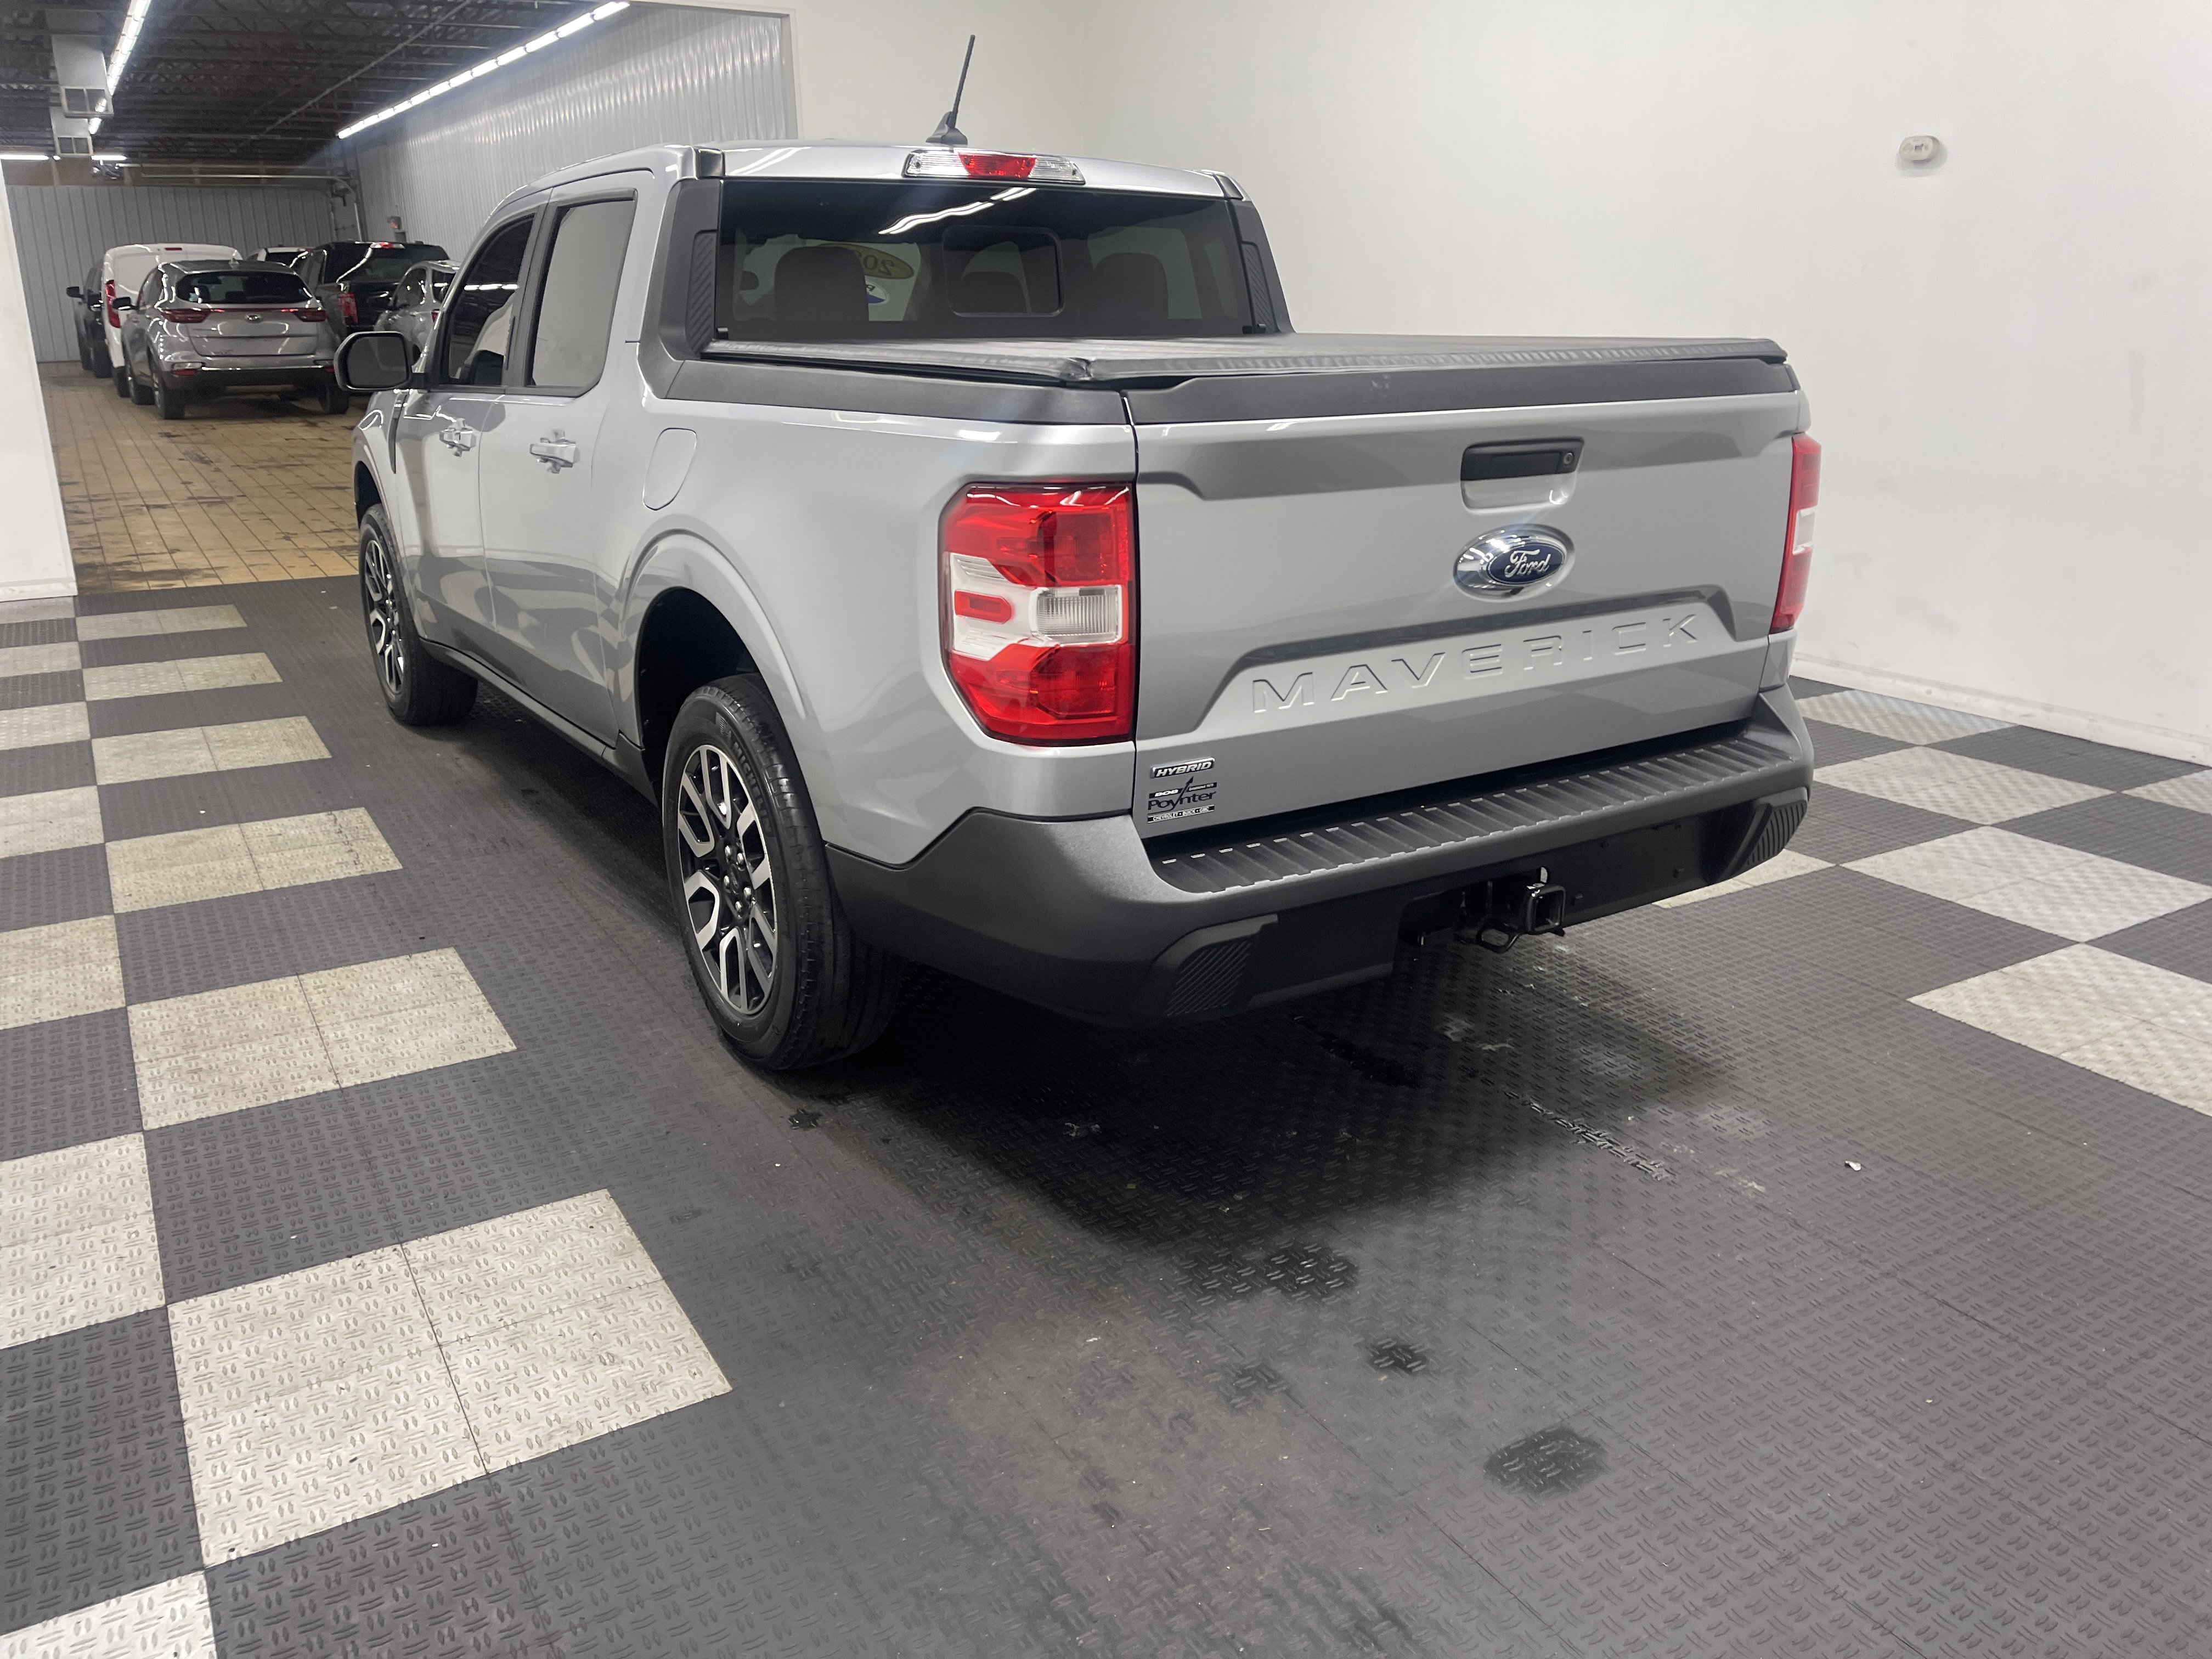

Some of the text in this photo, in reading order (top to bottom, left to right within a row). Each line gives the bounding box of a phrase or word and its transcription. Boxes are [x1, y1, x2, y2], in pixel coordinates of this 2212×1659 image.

[1504, 549, 1551, 578] Ford
[1252, 613, 1698, 713] MAVERICK
[1156, 761, 1212, 777] HYBRID
[731, 741, 773, 836] MICHELIN
[1154, 789, 1179, 797] BOB
[1148, 790, 1217, 814] Poynter
